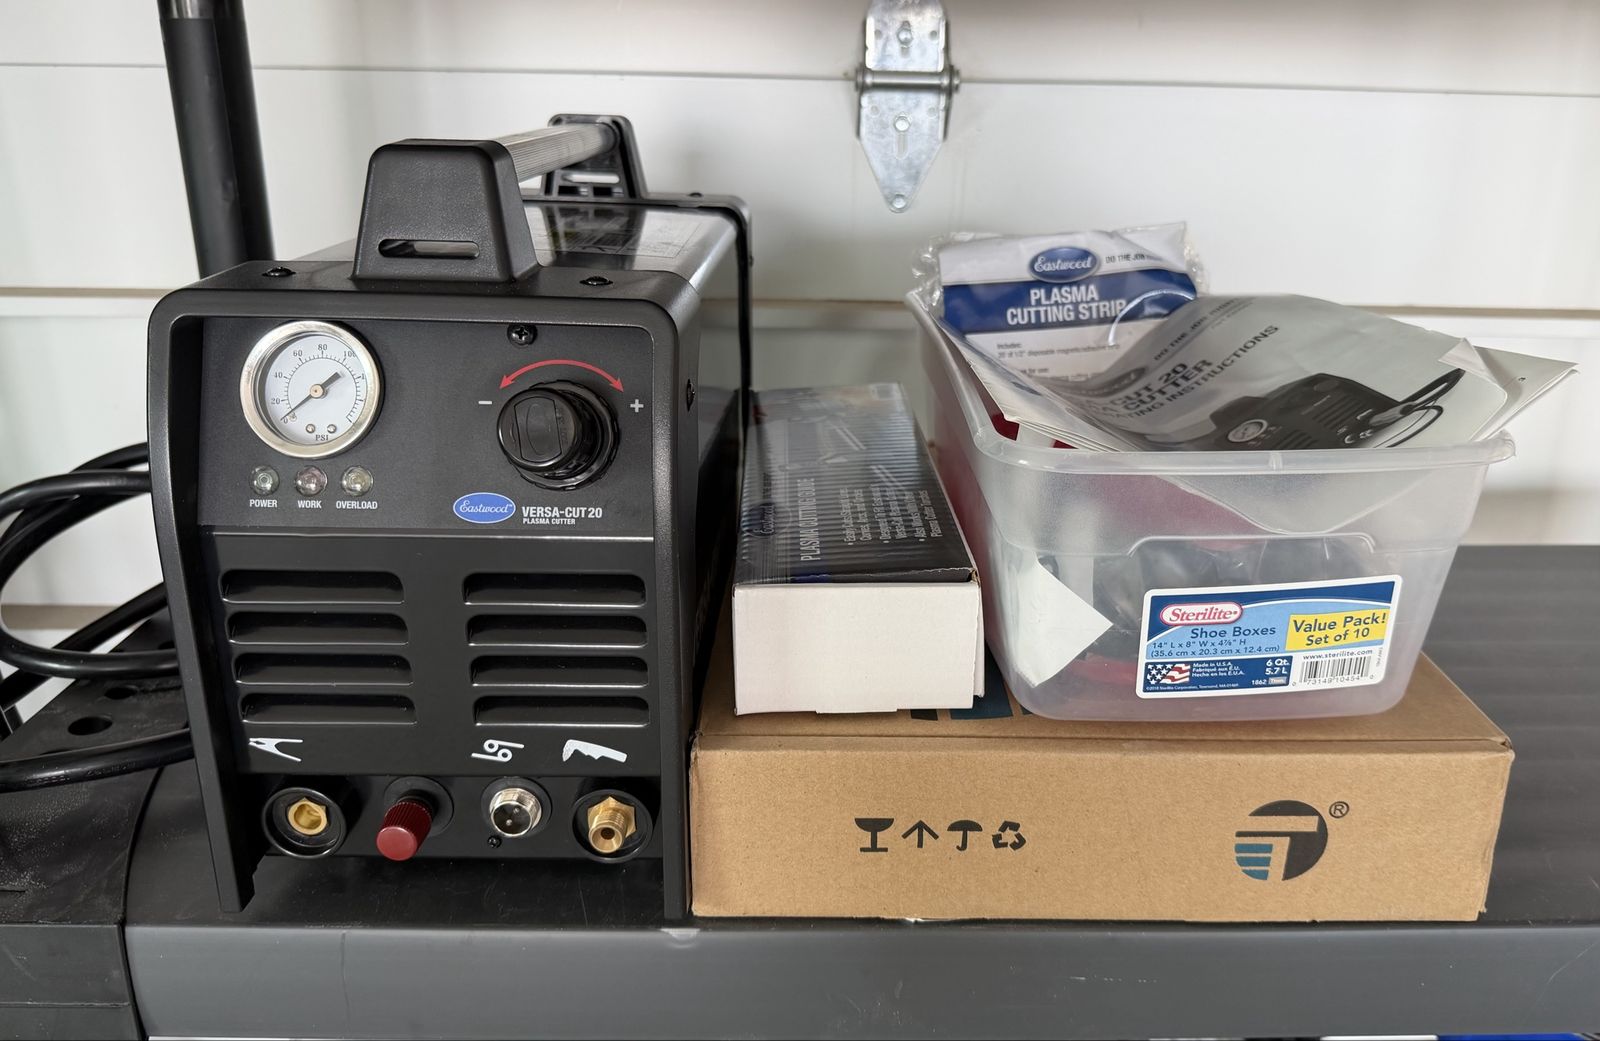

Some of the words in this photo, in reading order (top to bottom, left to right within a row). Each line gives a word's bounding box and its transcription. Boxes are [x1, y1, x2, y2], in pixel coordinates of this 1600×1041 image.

[1034, 256, 1092, 272] Eastwood
[1030, 284, 1099, 306] PLASMA
[1007, 304, 1075, 326] CUTTING
[1166, 325, 1279, 402] INSTRUCTIONS
[1158, 364, 1188, 383] 20
[1124, 360, 1213, 411] CUTTER
[250, 499, 278, 508] POWER
[298, 500, 322, 508] WORK
[336, 500, 378, 510] OVERLOAD
[522, 506, 586, 518] VERSA-CUT
[588, 507, 602, 518] 20
[752, 504, 776, 534] Eastwood
[798, 498, 818, 528] CUTTING
[929, 520, 943, 538] Plasma
[800, 529, 821, 560] PLASMA
[1170, 606, 1237, 622] Sterilite
[1293, 618, 1336, 632] Value
[1343, 613, 1386, 628] Pack!
[1190, 628, 1227, 638] Shoe
[1232, 626, 1276, 636] Boxes
[1306, 634, 1329, 646] Set
[1334, 630, 1350, 642] of
[1354, 628, 1370, 638] 10
[1151, 650, 1173, 658] (35.6
[1274, 658, 1290, 666] Qt.
[1303, 650, 1373, 660] www.sterilite.com
